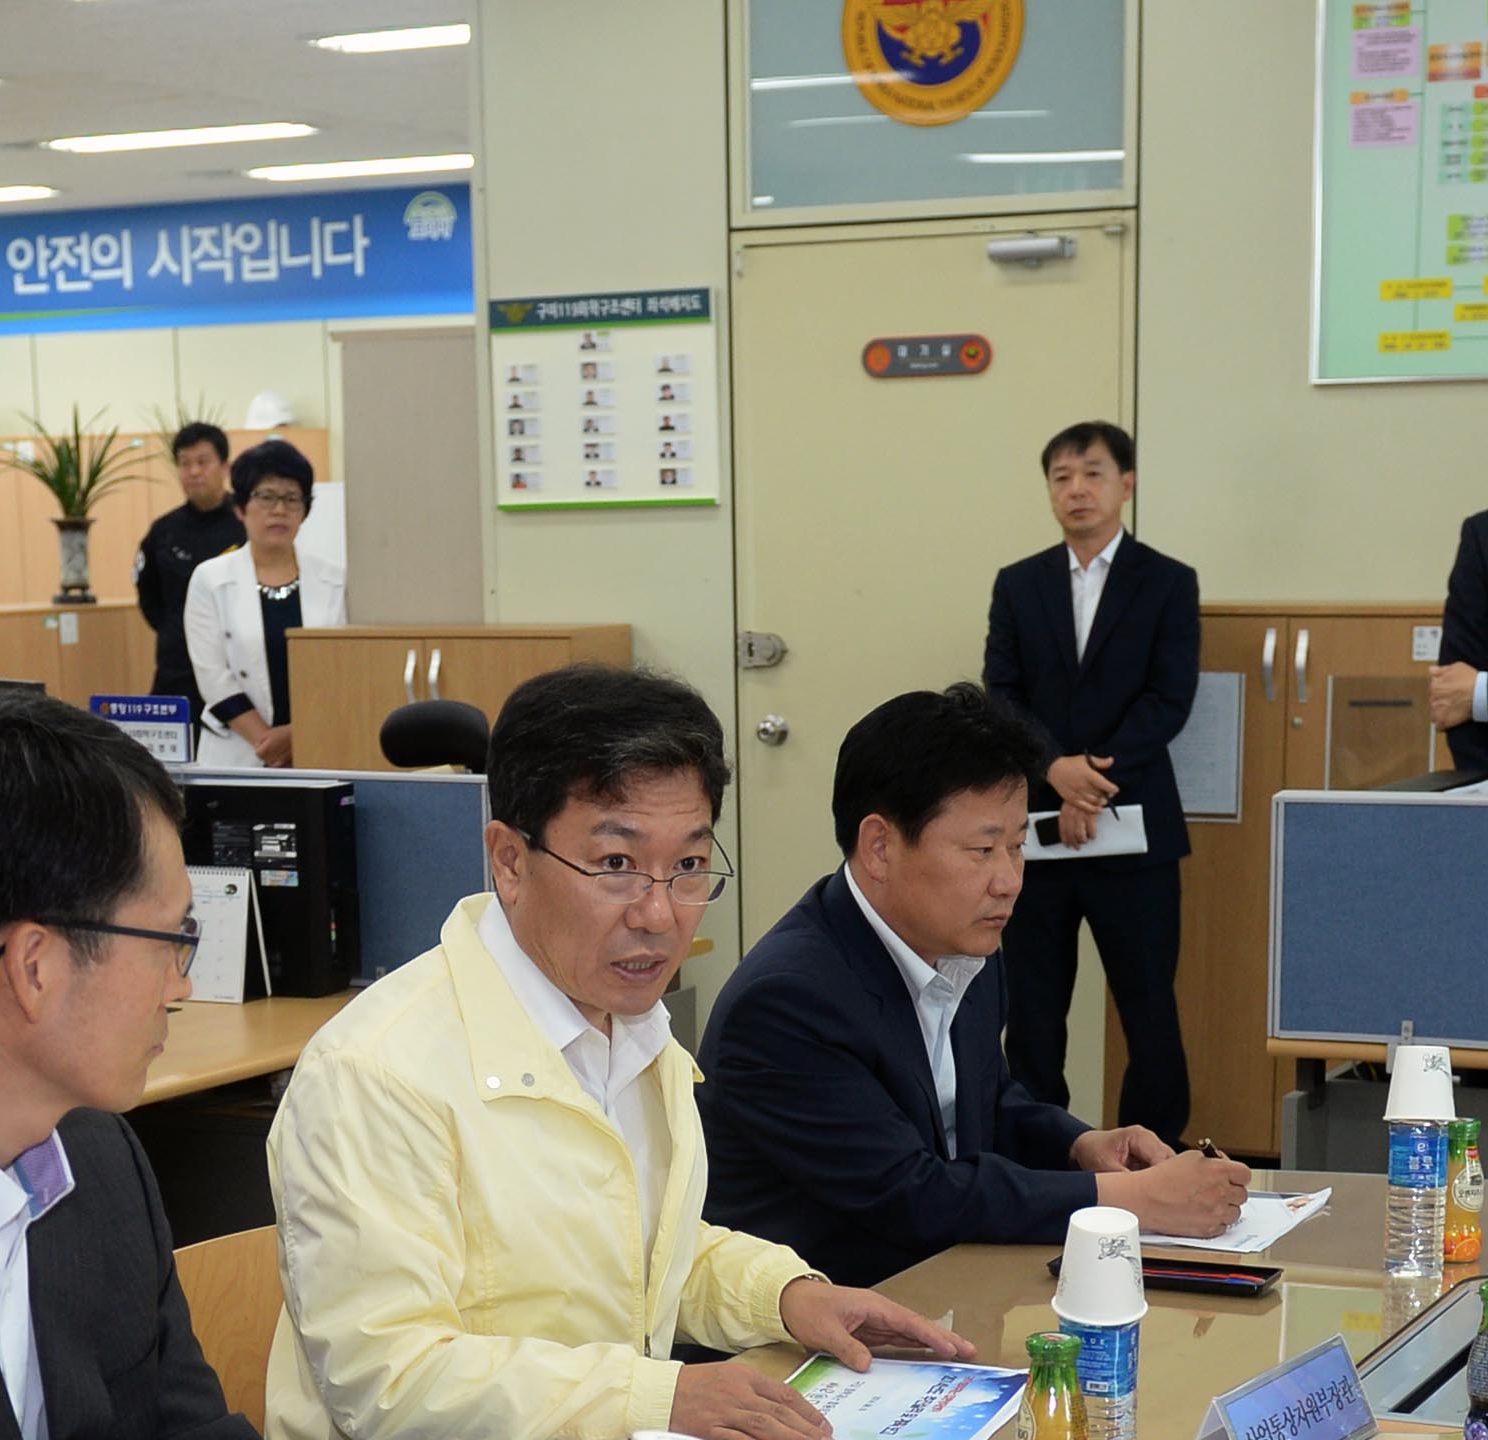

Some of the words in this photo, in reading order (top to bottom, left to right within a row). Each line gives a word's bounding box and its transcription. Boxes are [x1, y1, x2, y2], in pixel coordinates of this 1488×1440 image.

[5, 228, 134, 296] 안전의
[146, 212, 371, 287] 시작입니다
[1409, 1154, 1435, 1171] 블루
